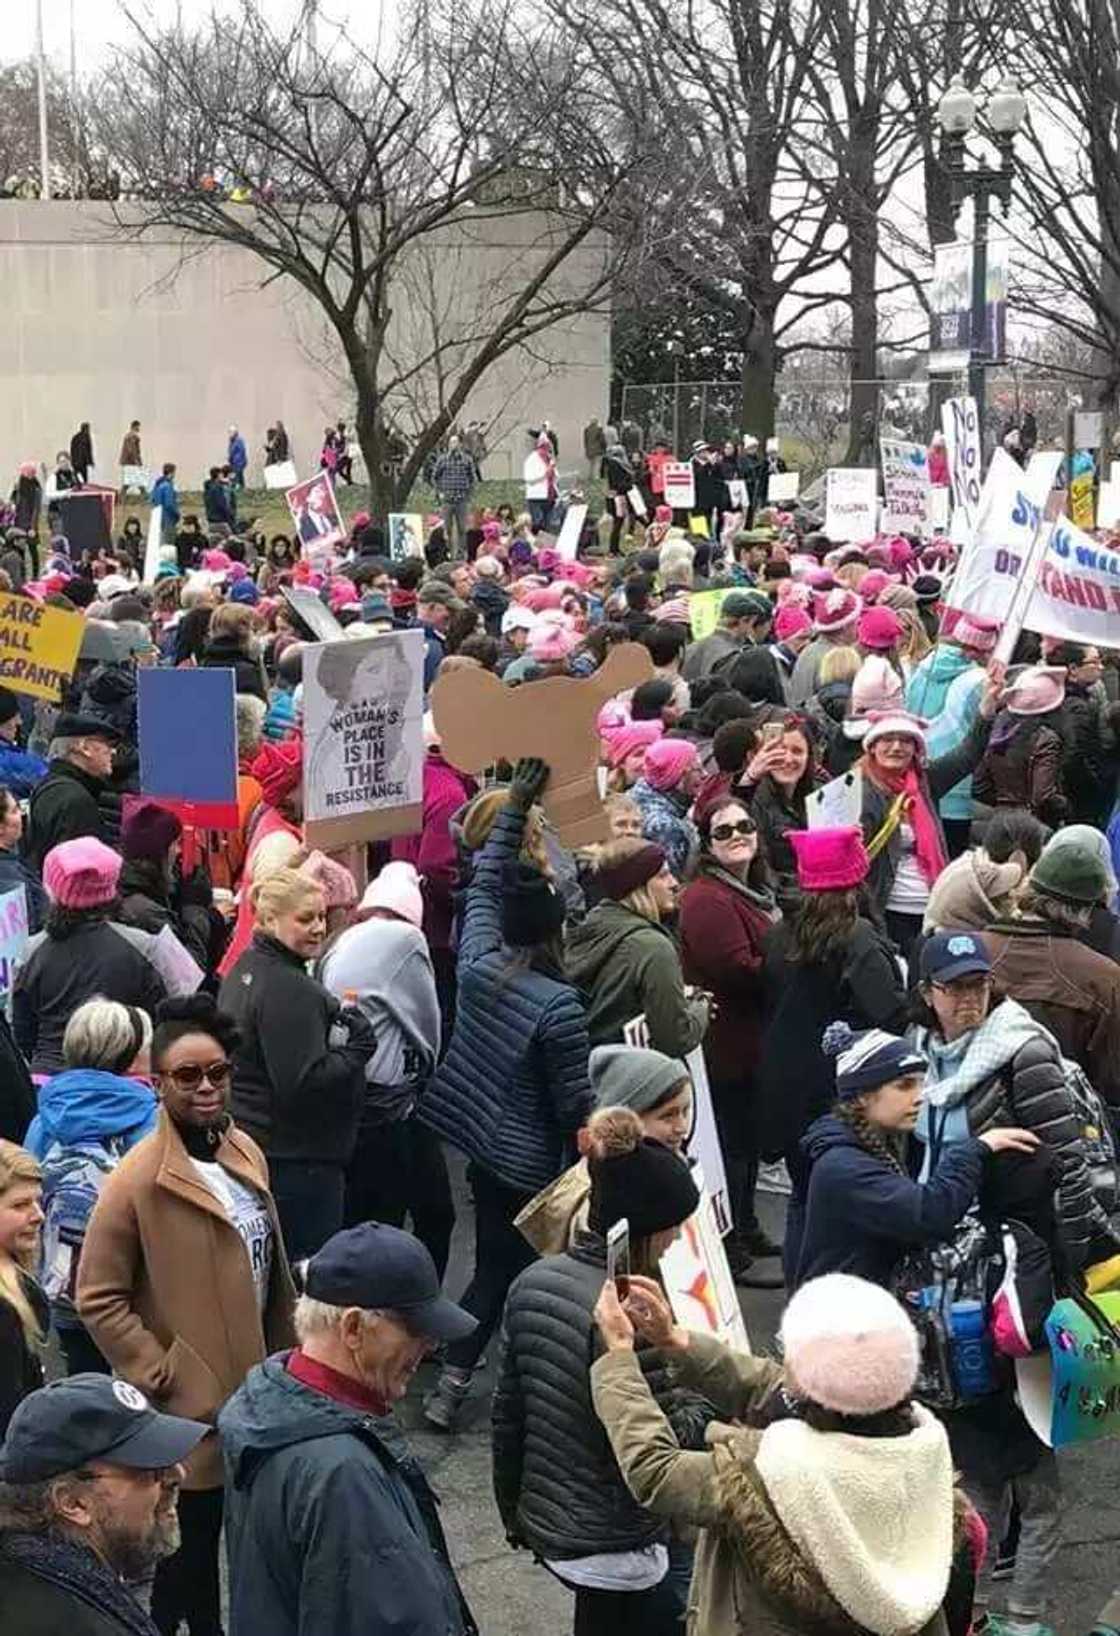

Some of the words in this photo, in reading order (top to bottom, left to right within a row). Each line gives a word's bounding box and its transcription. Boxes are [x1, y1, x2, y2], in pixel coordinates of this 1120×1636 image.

[1038, 559, 1108, 612] TAND
[4, 600, 45, 628] ARE
[344, 725, 385, 744] PLACE
[344, 745, 361, 763] IS
[367, 741, 385, 760] IN
[345, 762, 386, 786] THE
[326, 782, 403, 806] RESISTANCE
